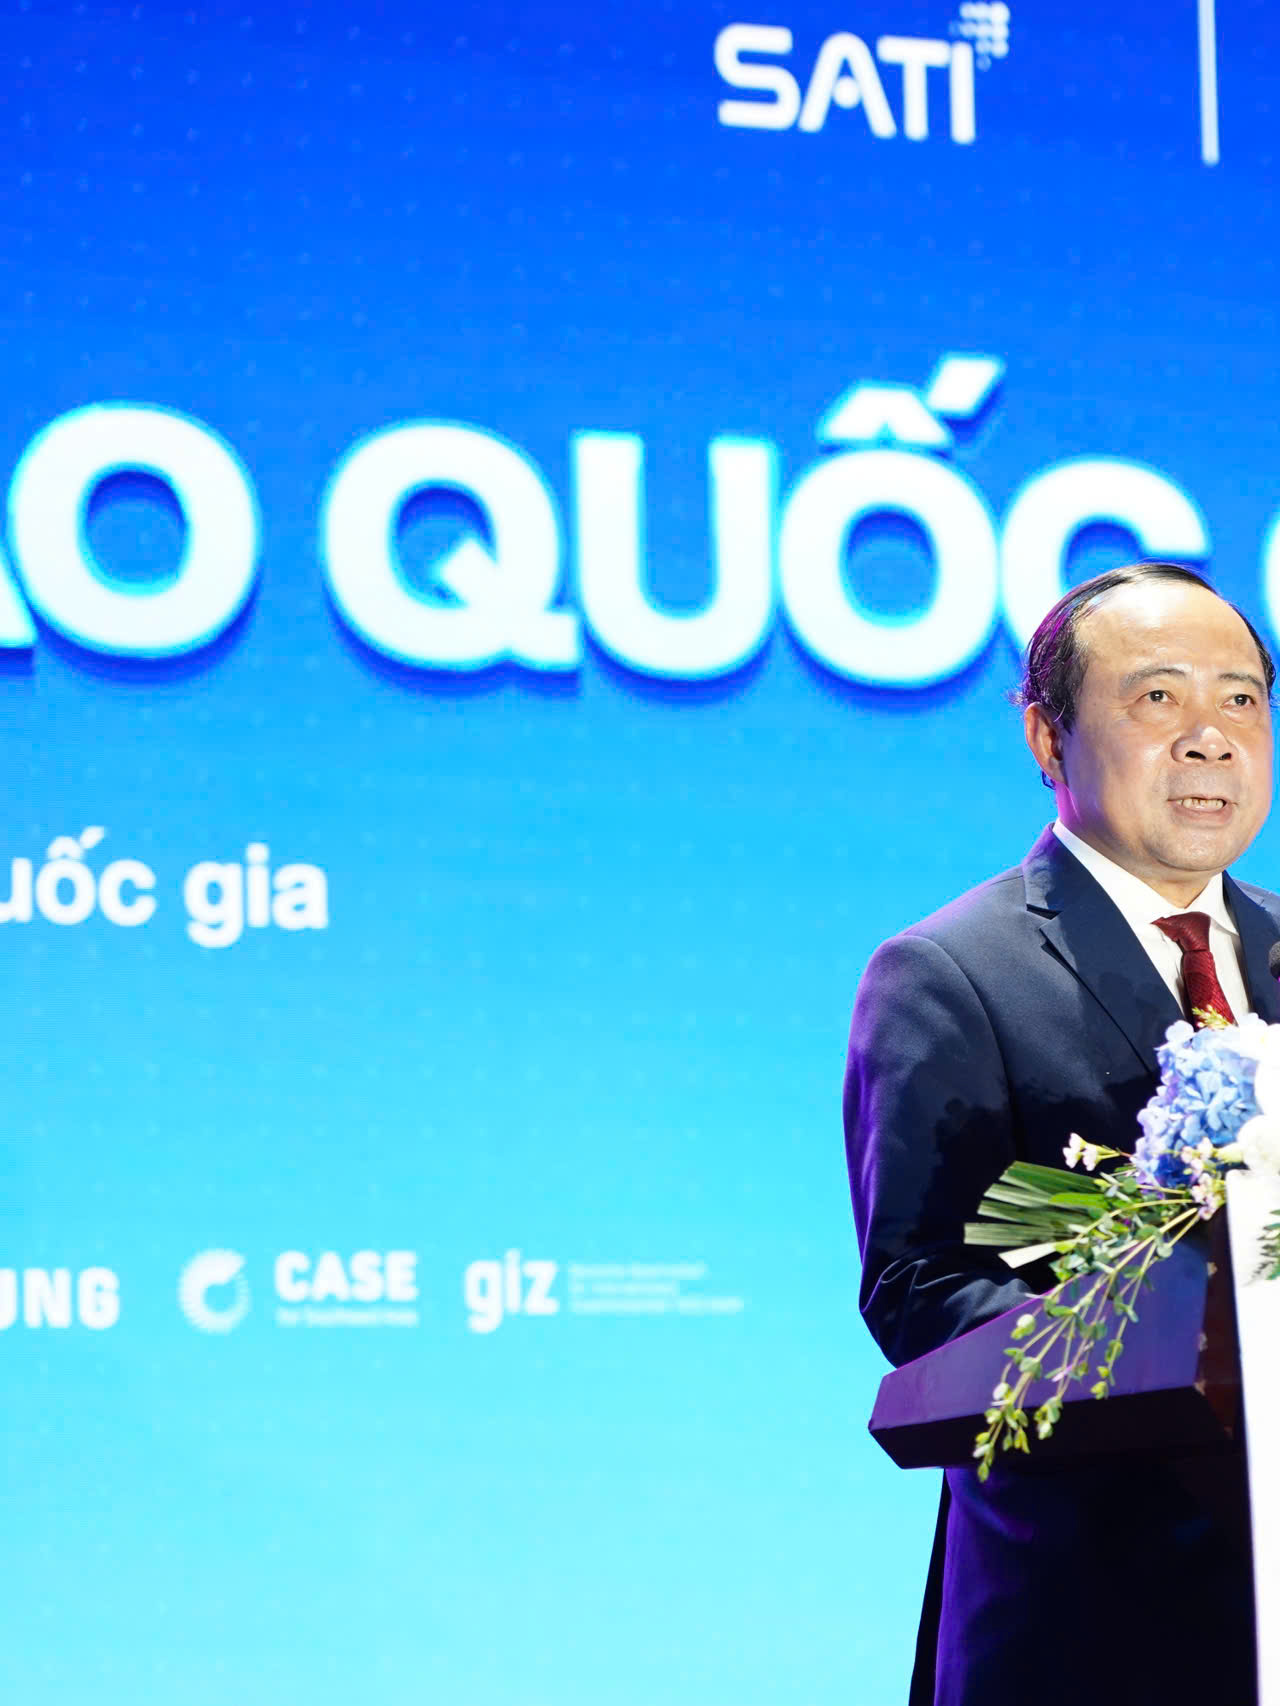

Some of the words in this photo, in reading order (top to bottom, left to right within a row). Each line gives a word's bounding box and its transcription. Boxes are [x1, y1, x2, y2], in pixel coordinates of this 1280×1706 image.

[714, 23, 975, 144] SATI
[0, 402, 260, 660] O
[322, 354, 1208, 690] QUỐC
[184, 842, 329, 948] gia
[275, 1250, 419, 1302] CASE
[464, 1249, 559, 1334] giz
